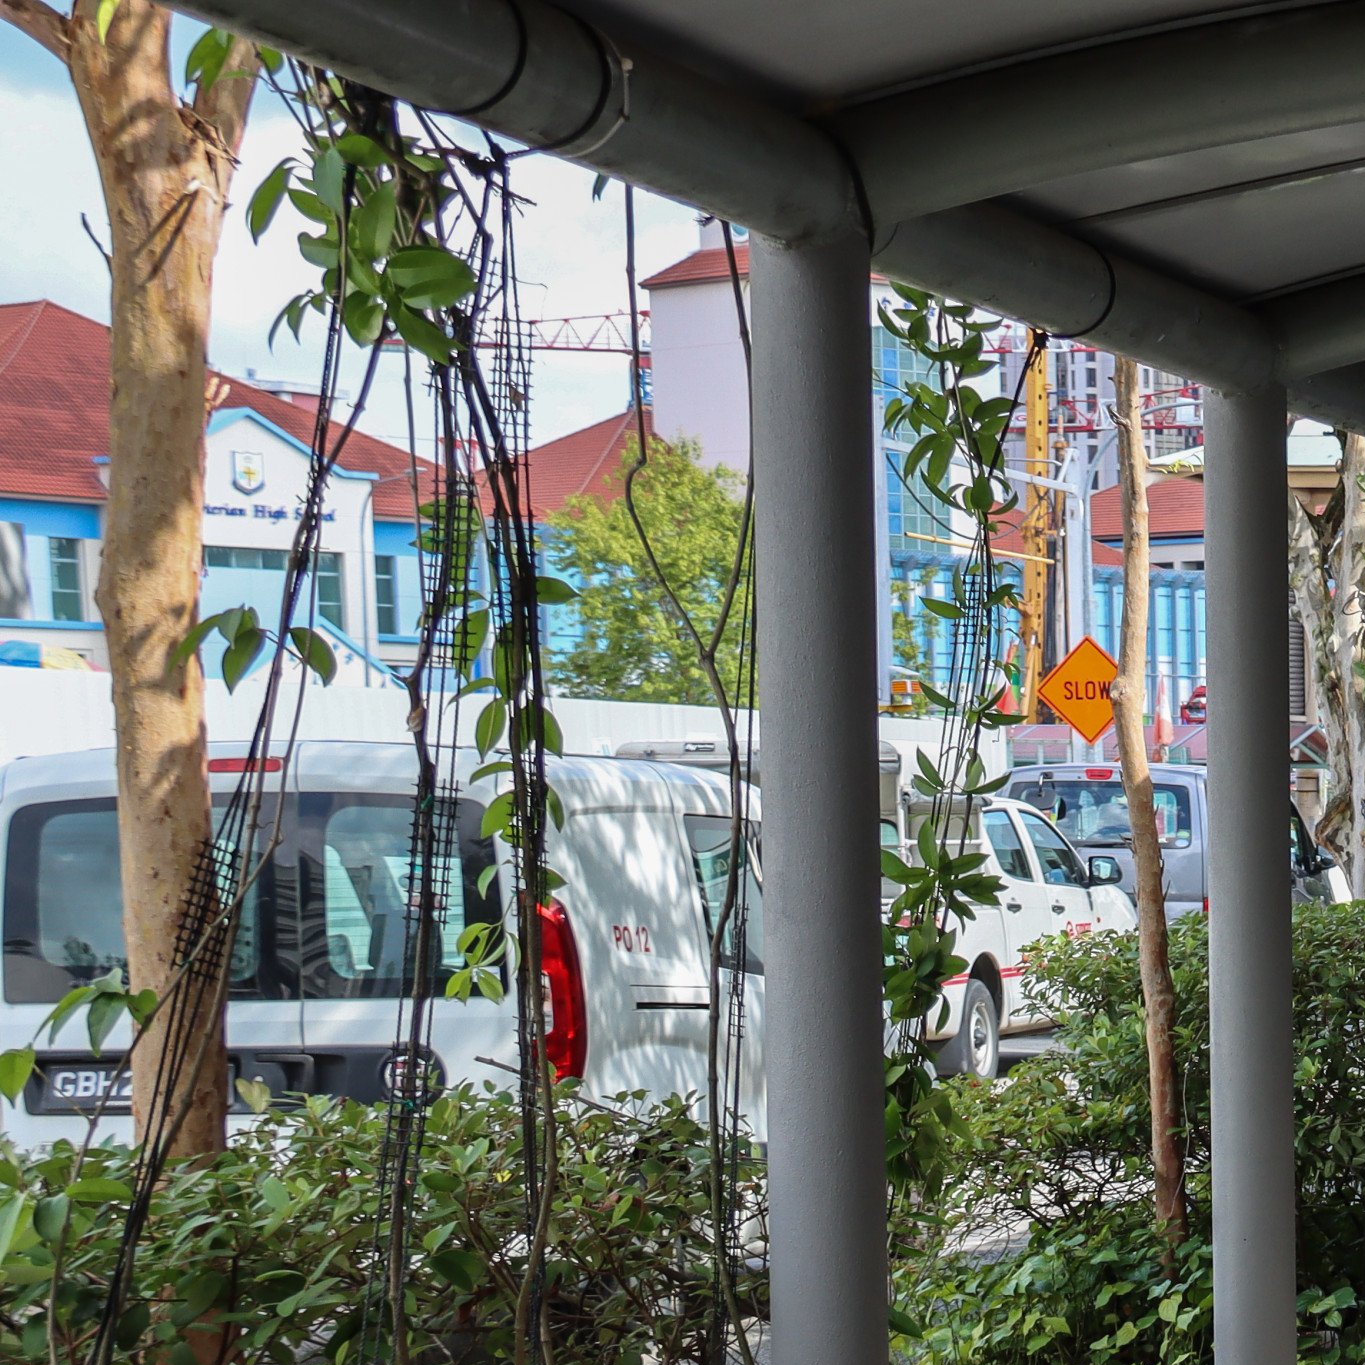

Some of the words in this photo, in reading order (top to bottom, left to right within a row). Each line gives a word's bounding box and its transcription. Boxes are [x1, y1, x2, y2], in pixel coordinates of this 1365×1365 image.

[254, 504, 287, 524] High
[1064, 681, 1111, 700] SLOW
[613, 925, 633, 952] PO
[636, 926, 651, 952] 12
